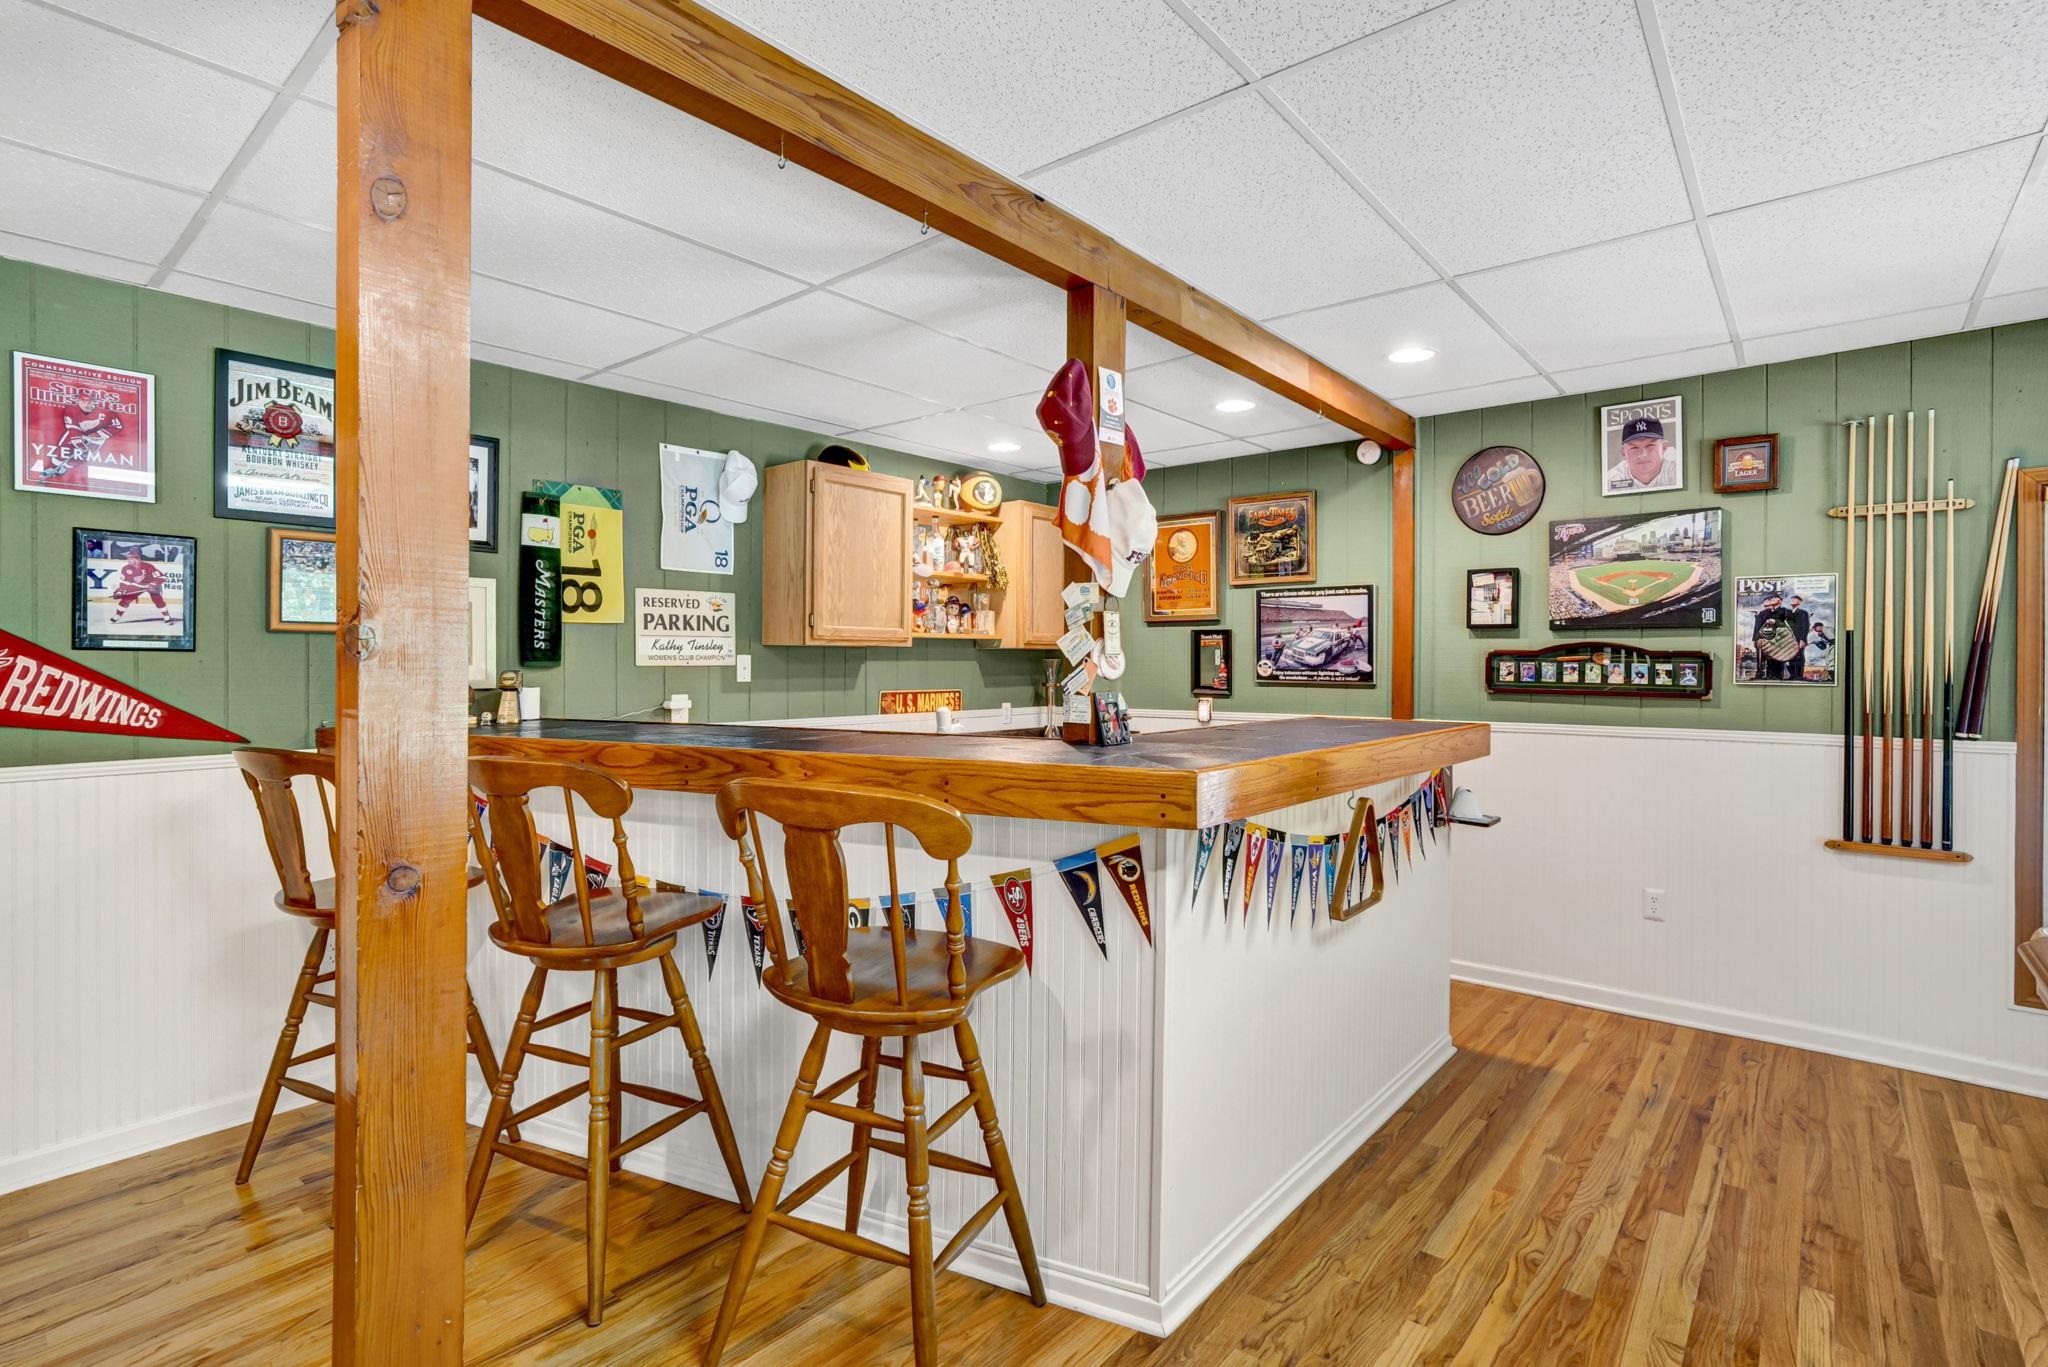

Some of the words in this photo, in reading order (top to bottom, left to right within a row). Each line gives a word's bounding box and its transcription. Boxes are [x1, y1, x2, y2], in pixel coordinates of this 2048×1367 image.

[24, 360, 102, 378] COMMEMORATIVE
[107, 374, 142, 385] EDITION
[1610, 403, 1672, 425] SPORTS
[31, 443, 134, 467] YZERMAN
[241, 444, 282, 457] KENTUCKY
[246, 454, 283, 467] BOURBON
[286, 460, 319, 471] WHISKEY
[234, 486, 258, 498] JAMES
[1462, 484, 1514, 518] BEER
[685, 486, 698, 534] PGA
[573, 512, 585, 554] PGA
[715, 550, 729, 568] 18
[562, 559, 603, 614] 18
[1739, 578, 1784, 593] POST
[643, 597, 700, 609] RESERVED
[643, 613, 730, 632] PARKING
[651, 638, 684, 655] Kathy
[687, 639, 724, 655] Tinsley
[0, 655, 162, 729] REDWINGS
[896, 694, 905, 713] U.
[907, 693, 915, 713] S.
[917, 692, 955, 712] MARINES
[551, 876, 561, 905] EAGLE
[1267, 876, 1275, 909] RAVENS
[1128, 883, 1149, 927] REDSKINS
[1015, 917, 1029, 947] 49ERS
[1087, 907, 1106, 945] CHARGERS
[707, 930, 716, 956] TITANS
[753, 935, 763, 968] TEXANS
